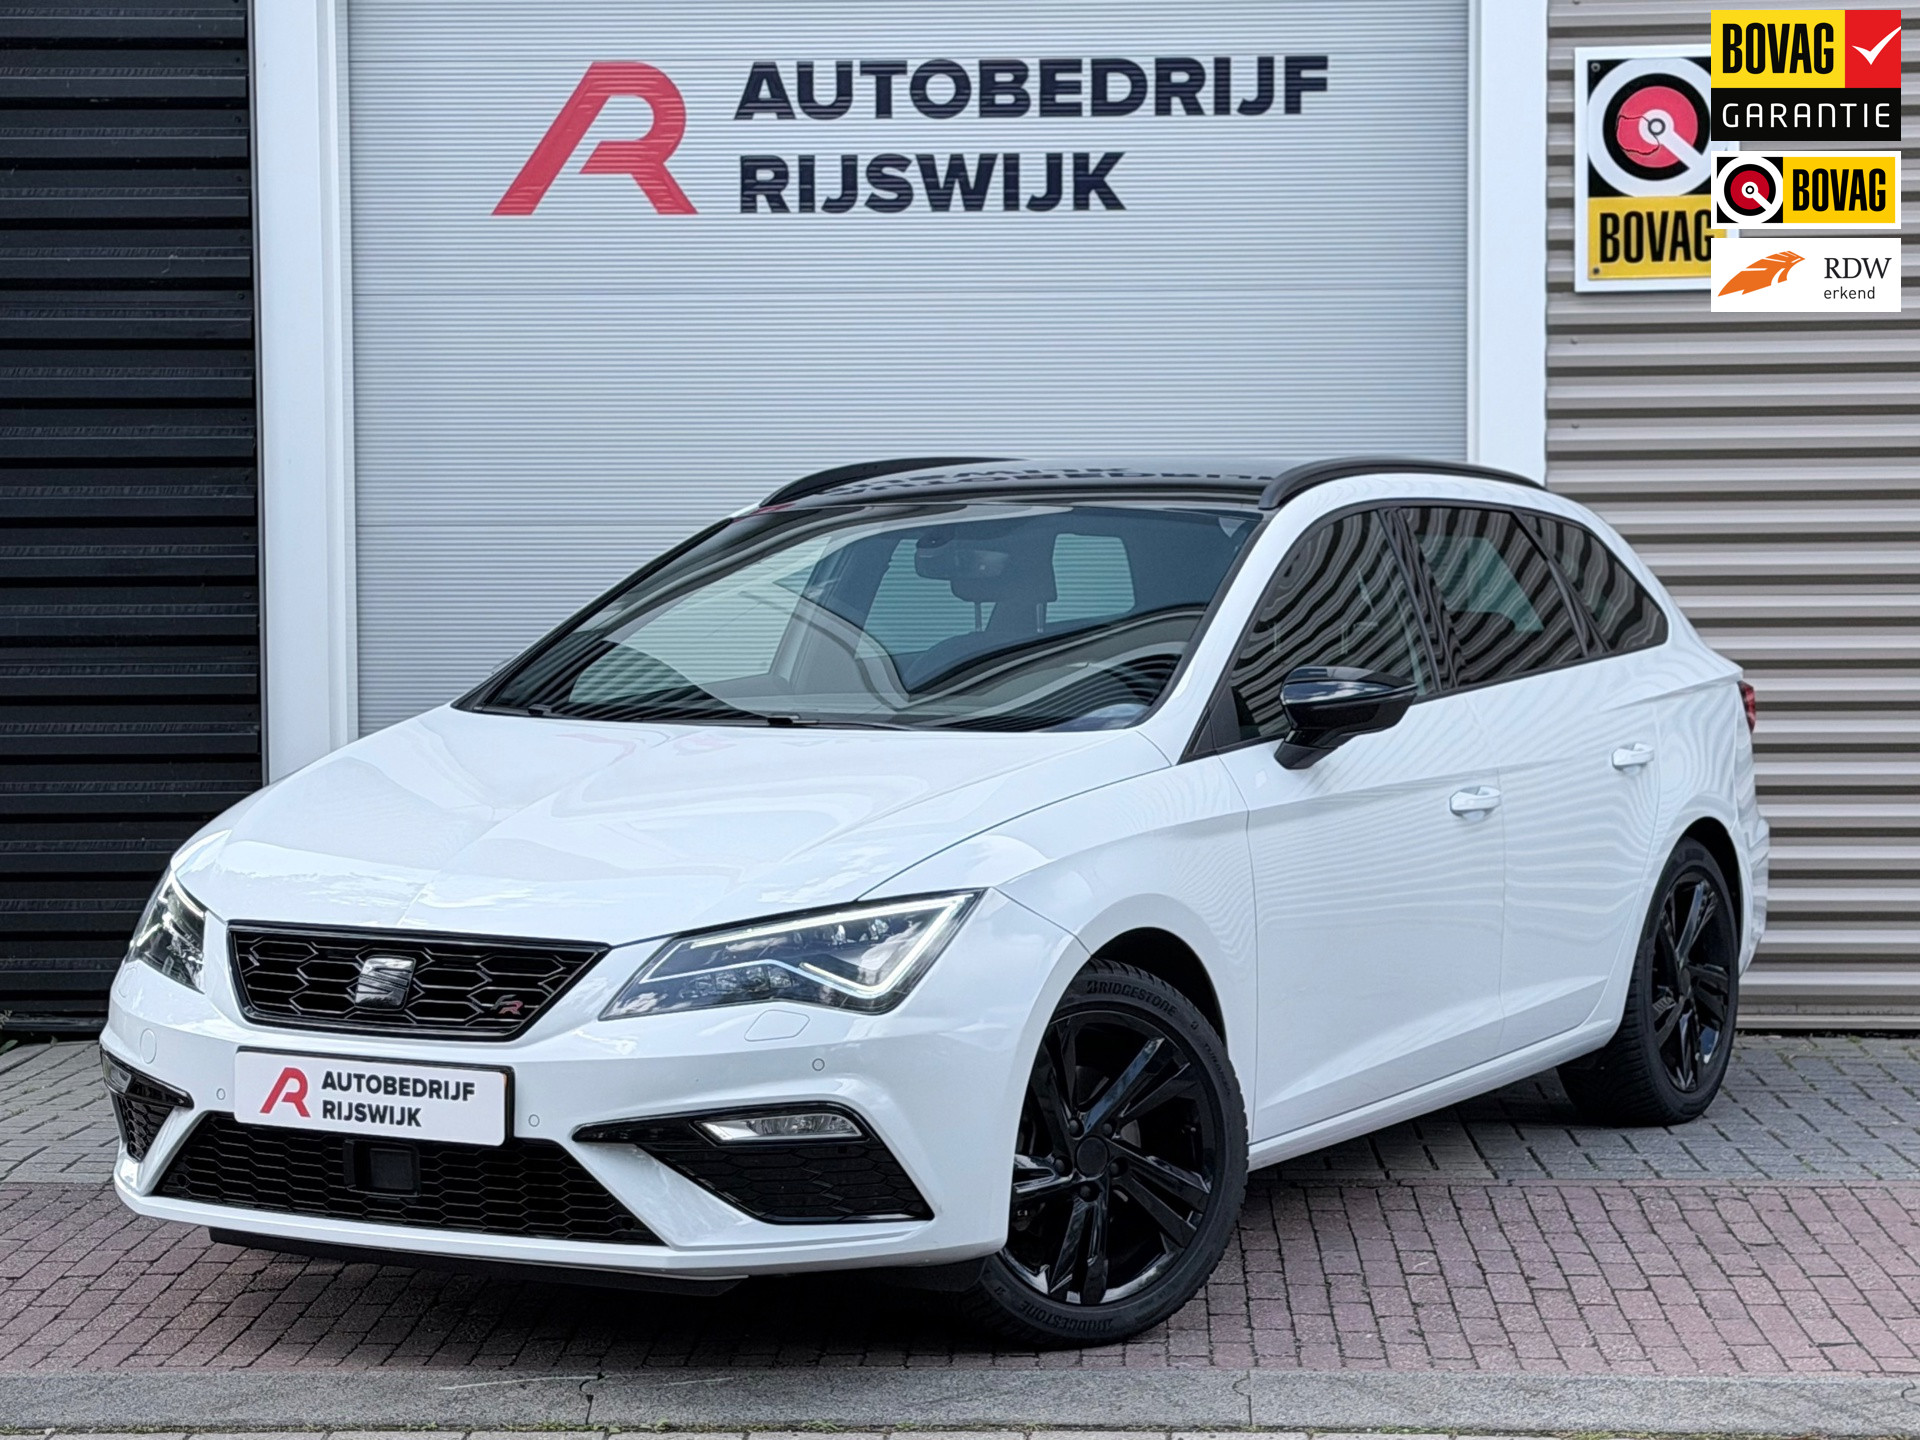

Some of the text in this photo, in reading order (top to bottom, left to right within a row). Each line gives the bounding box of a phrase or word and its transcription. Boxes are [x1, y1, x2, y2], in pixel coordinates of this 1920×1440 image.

[733, 55, 1329, 121] AUTOBEDRIJF
[739, 151, 1126, 214] RIJSWIJK
[1600, 209, 1714, 264] BOVAG
[1086, 980, 1178, 1017] BRIDGESTONE
[321, 1070, 476, 1102] AUTOBEDRIJF
[322, 1099, 422, 1128] RIJSWIJK
